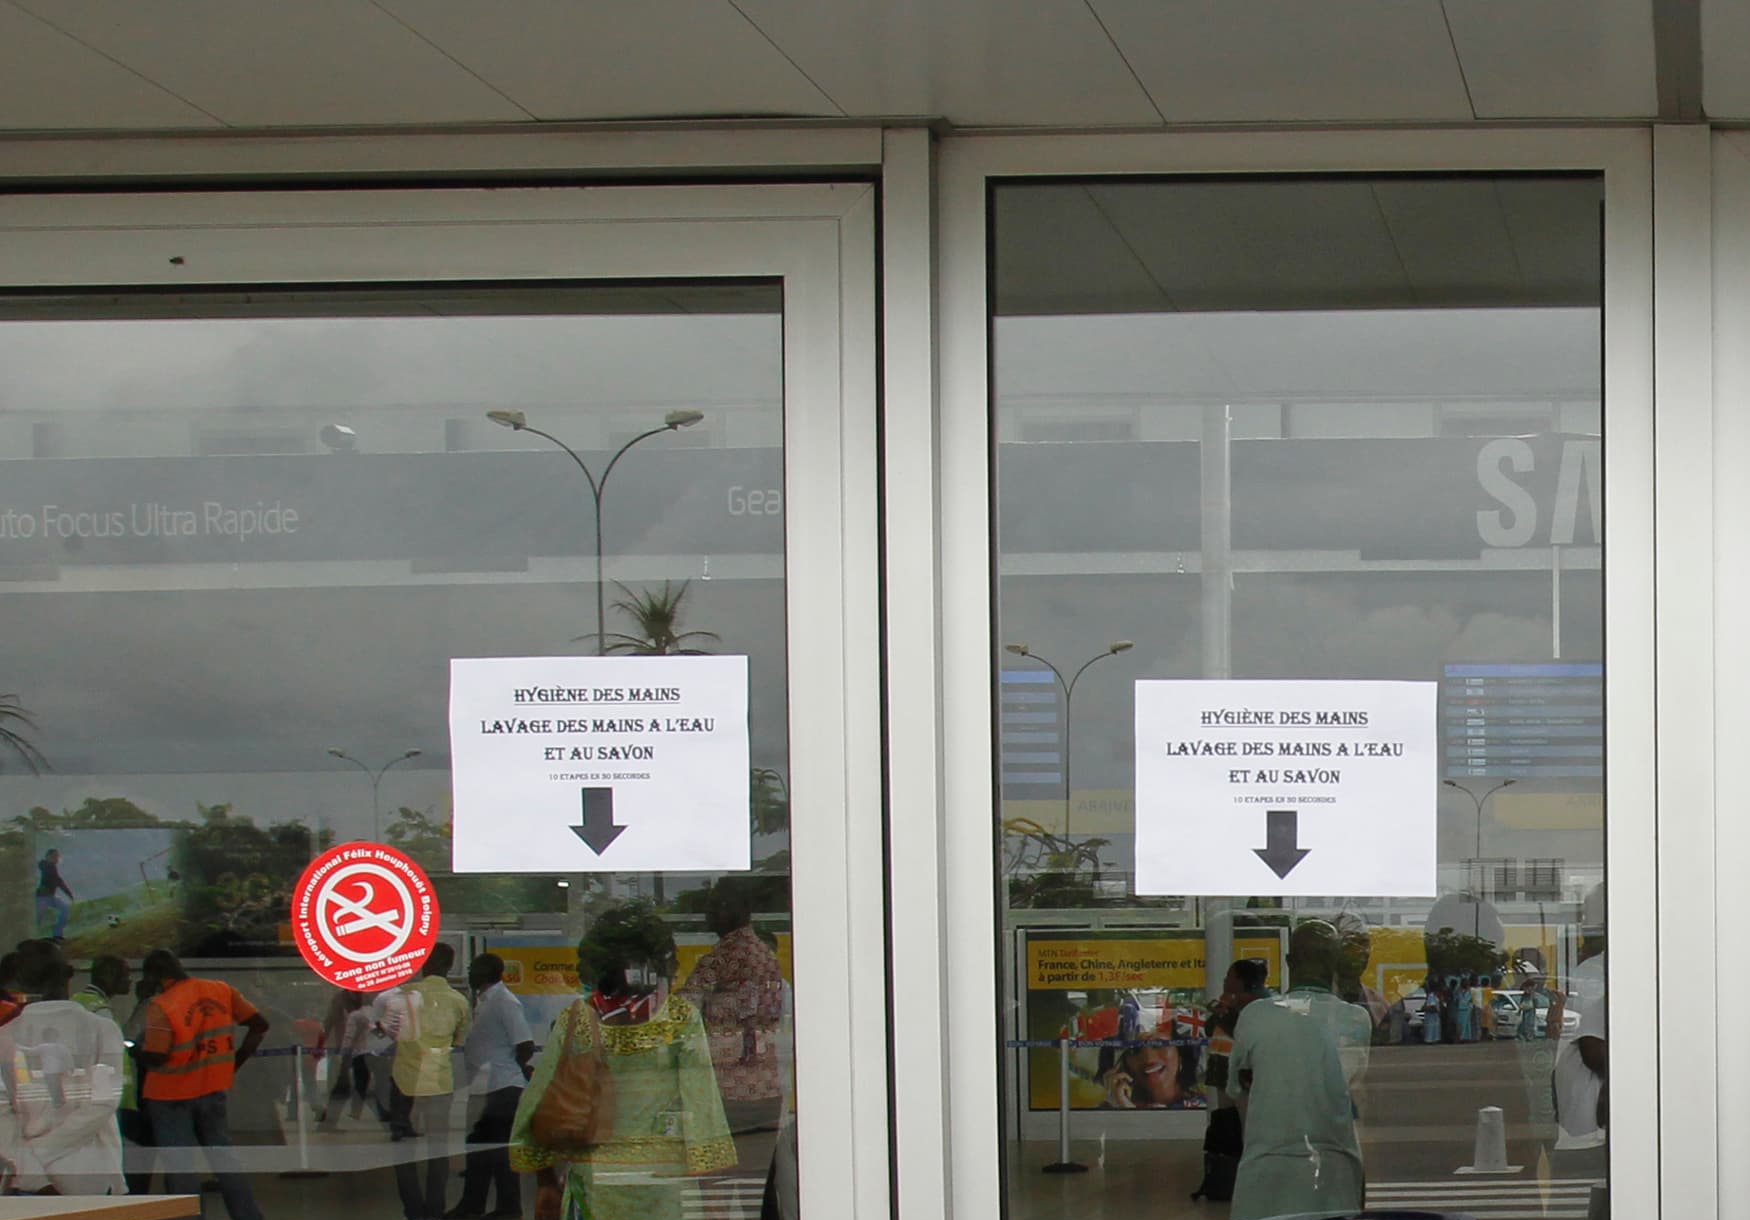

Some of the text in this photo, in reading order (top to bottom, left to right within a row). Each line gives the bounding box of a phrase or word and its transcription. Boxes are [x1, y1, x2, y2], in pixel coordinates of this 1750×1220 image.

[42, 504, 125, 538] Focus
[131, 503, 197, 537] Ultra
[204, 500, 298, 541] Rapide
[514, 685, 680, 702] HYGIÈNE DES MAINS
[1200, 708, 1369, 726] HYGIÈNE DES MAINS
[481, 718, 551, 734] LAVAGE
[557, 719, 588, 733] DES
[592, 718, 645, 733] MAINS
[649, 719, 662, 732] A
[544, 744, 654, 761] ET AU SAVON
[1167, 740, 1237, 756] LAVAGE
[1242, 742, 1274, 756] DES
[1278, 742, 1333, 756] MAINS
[1336, 743, 1349, 756] A
[1229, 768, 1341, 784] ET AU SAVON
[343, 849, 372, 861] Félix
[300, 854, 342, 919] International
[419, 895, 433, 935] Boigny
[300, 922, 333, 967] Aéroport
[335, 948, 427, 981] Zone non fumeur
[1080, 959, 1116, 971] Chine,
[1118, 959, 1178, 972] Angleterre
[1180, 960, 1192, 968] et
[1038, 971, 1045, 982] à
[1047, 972, 1080, 984] partir
[1082, 971, 1096, 981] de
